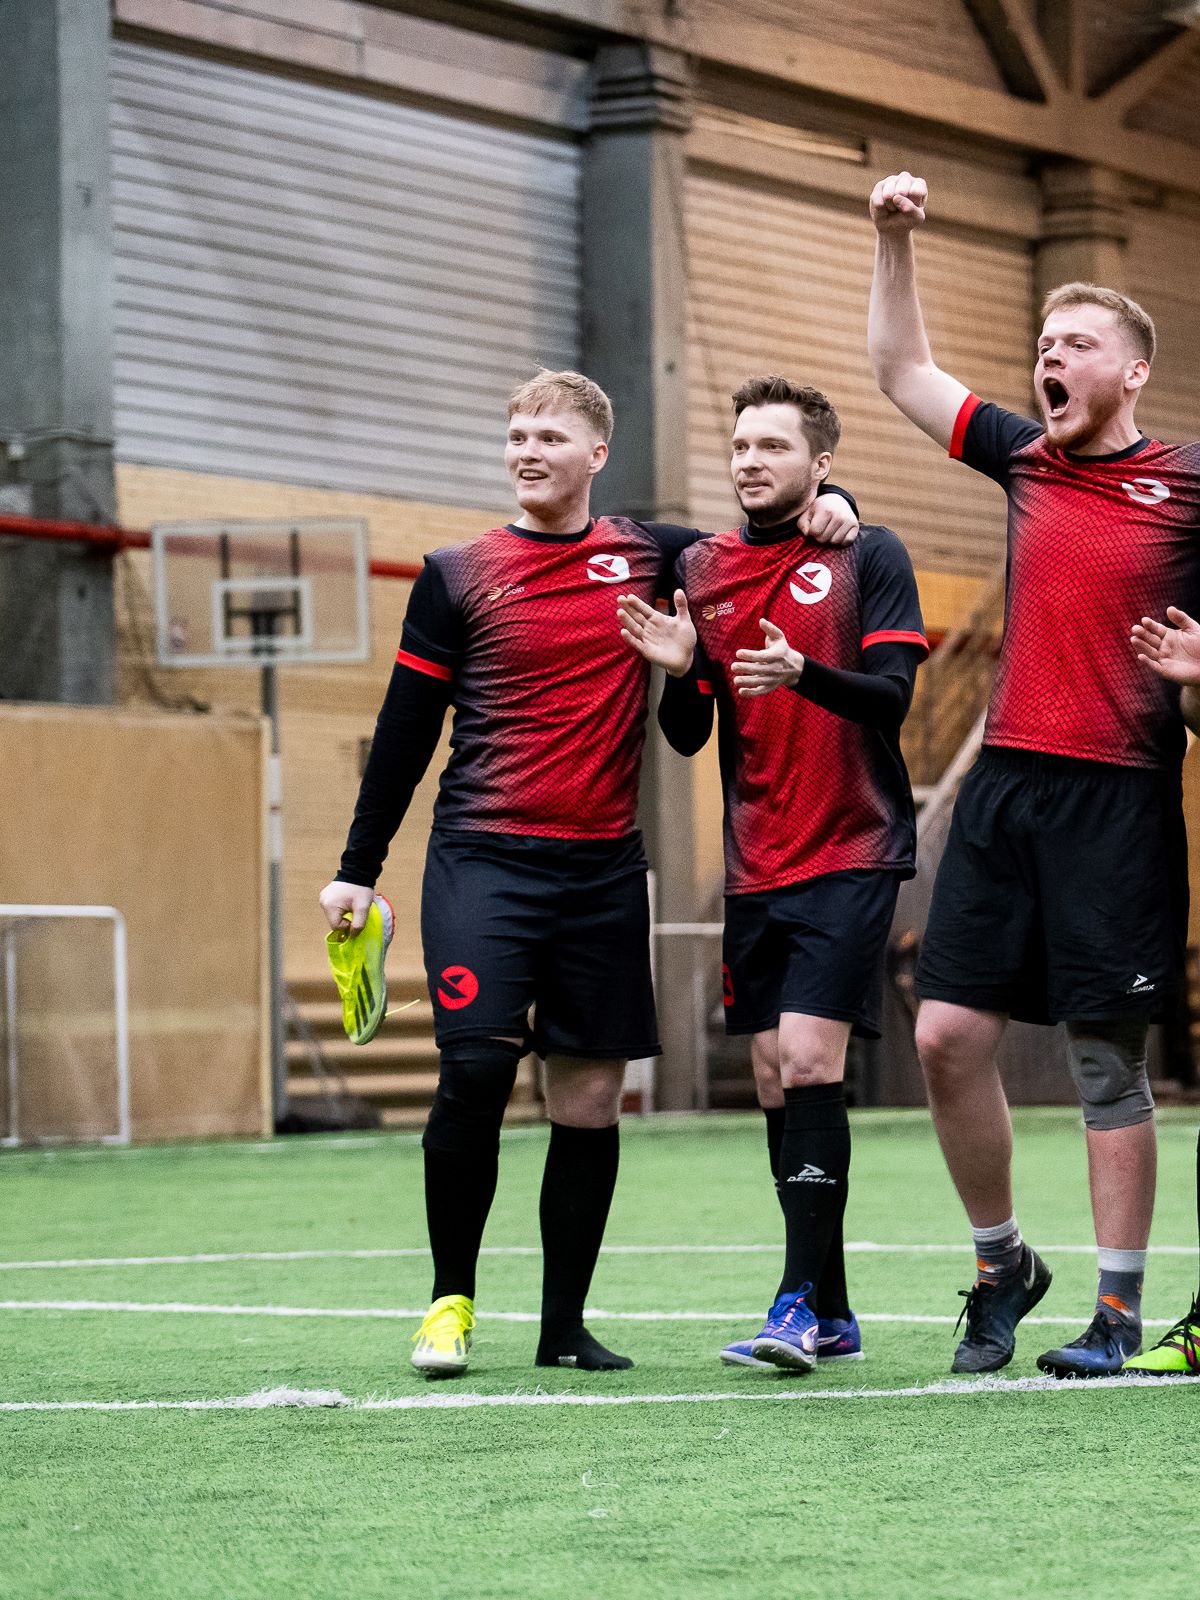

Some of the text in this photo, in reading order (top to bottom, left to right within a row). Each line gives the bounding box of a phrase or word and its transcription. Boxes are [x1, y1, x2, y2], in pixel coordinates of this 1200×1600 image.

[716, 601, 733, 611] LOGO
[716, 607, 736, 617] SPORT
[786, 1176, 837, 1185] DEMIX
